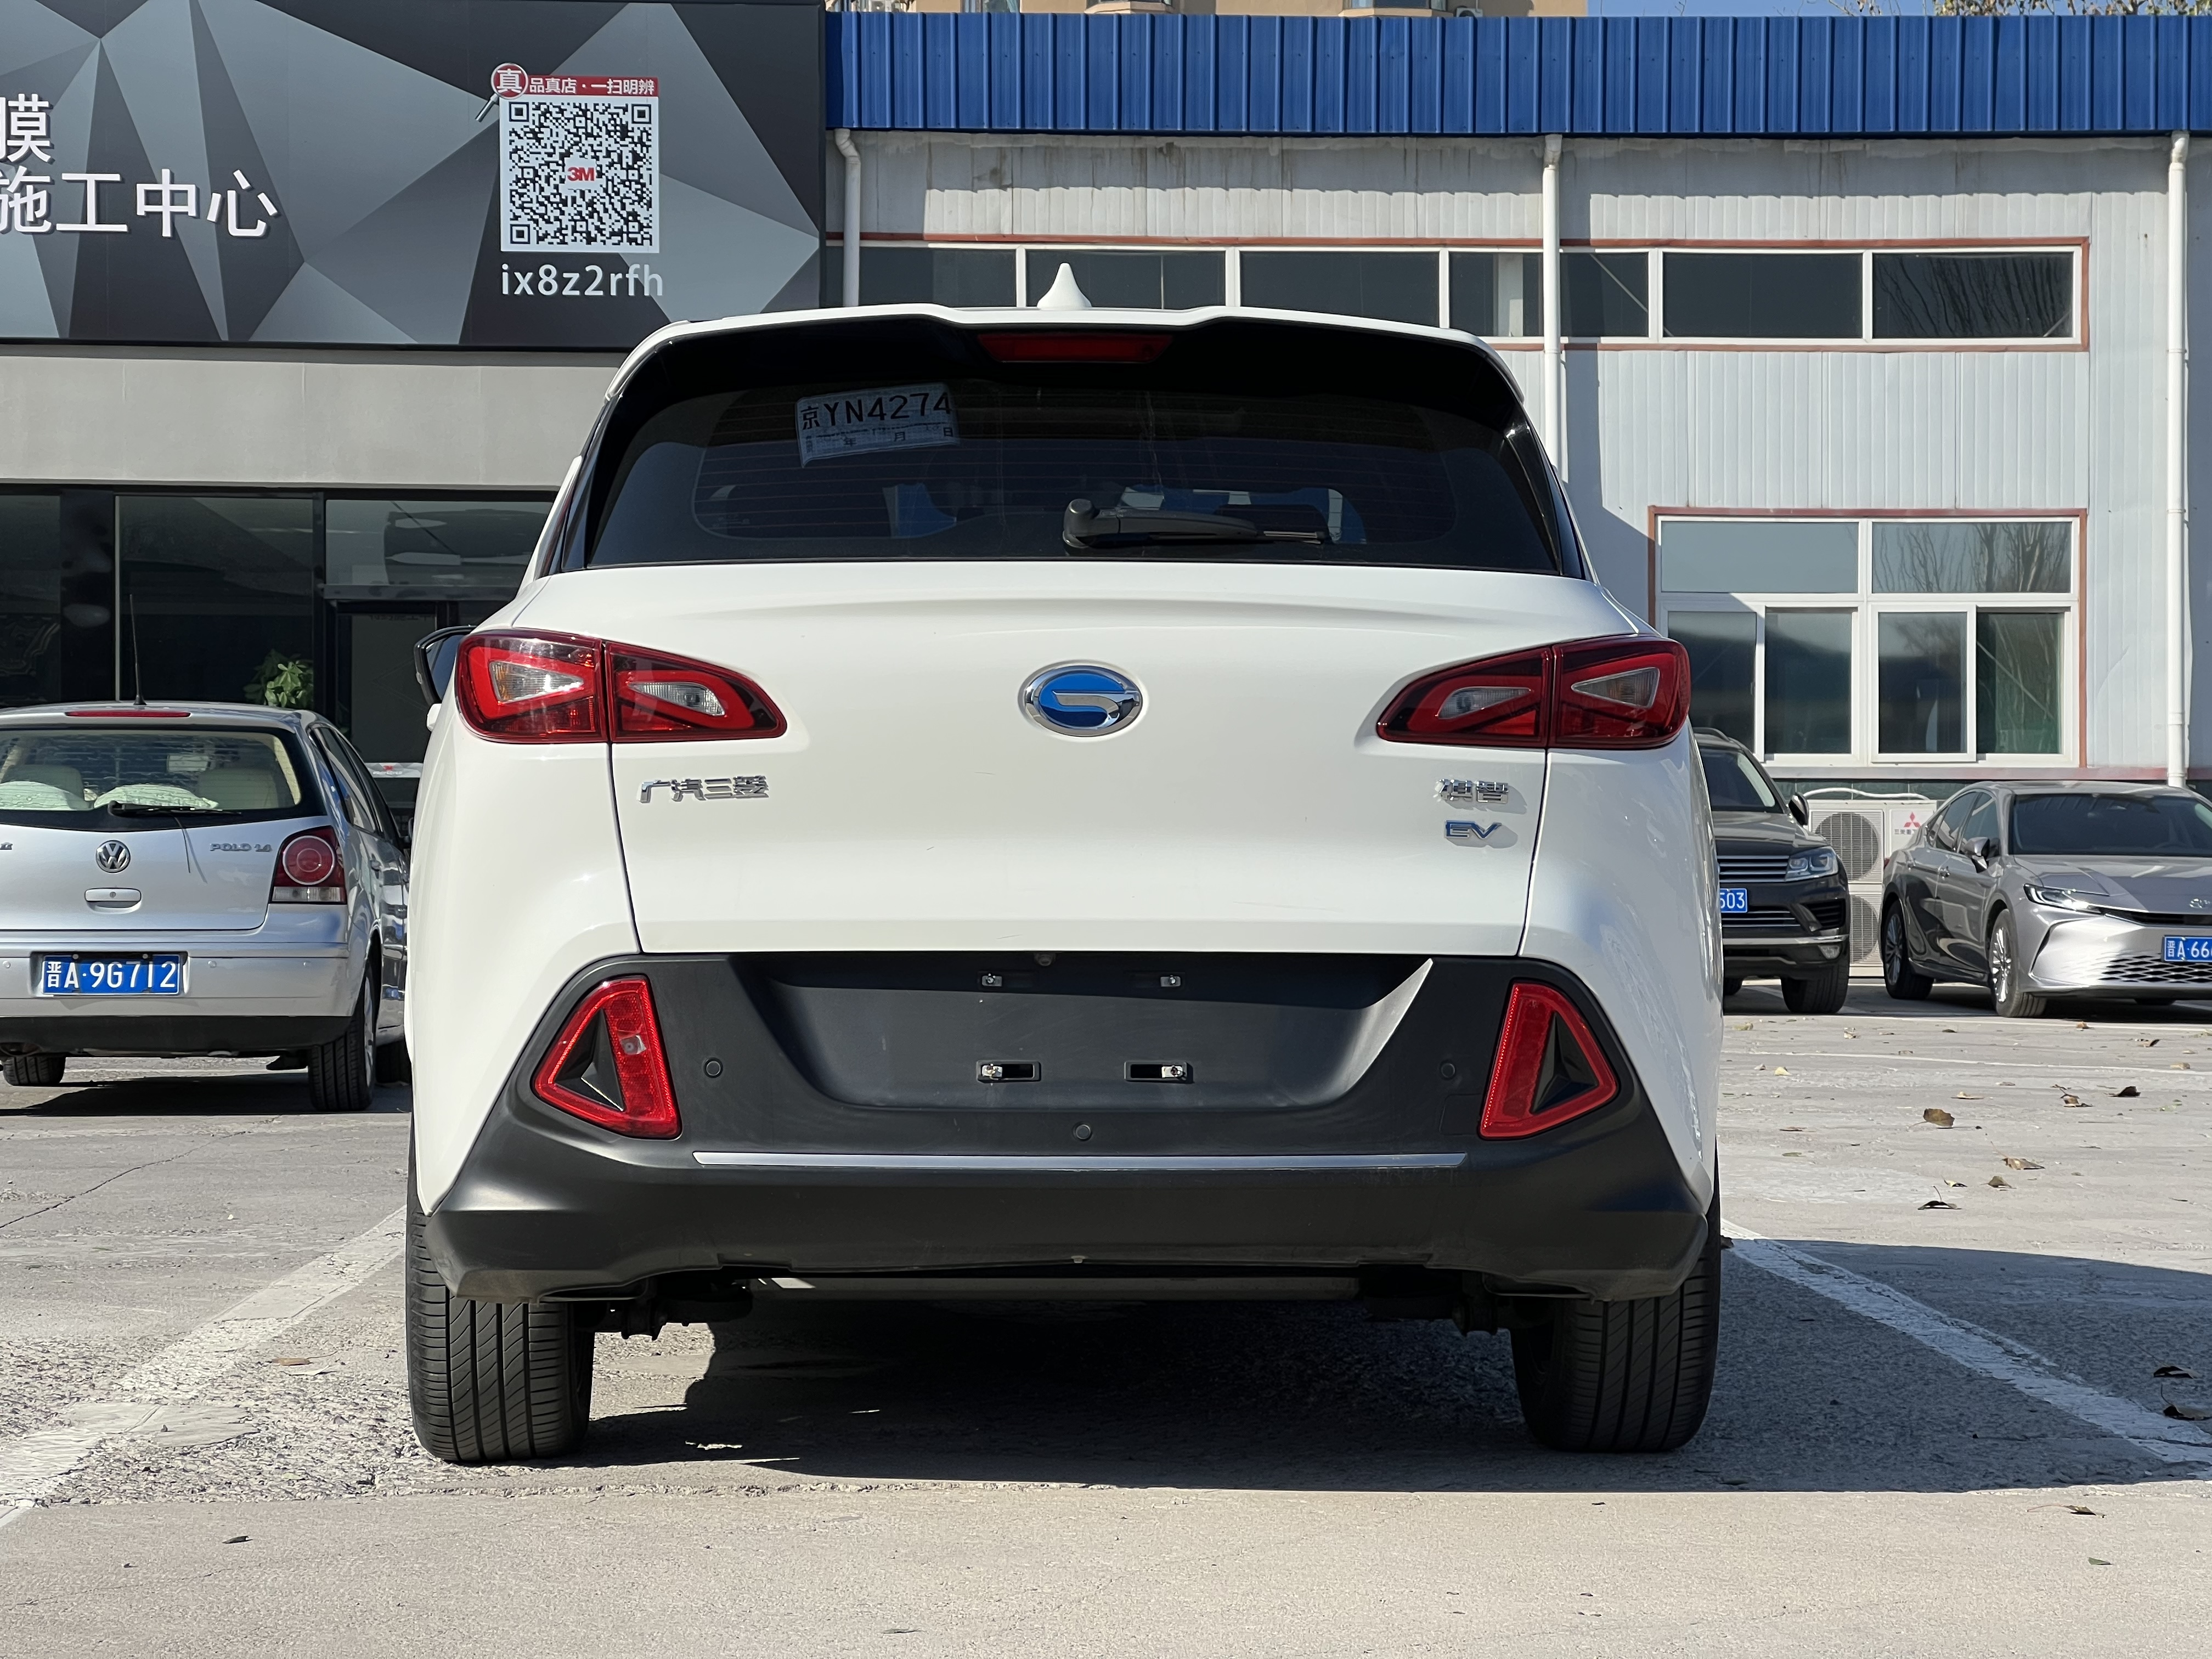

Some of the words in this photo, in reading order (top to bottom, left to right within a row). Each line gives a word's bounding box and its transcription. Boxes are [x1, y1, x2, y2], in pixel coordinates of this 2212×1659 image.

[567, 167, 595, 182] 3M
[0, 166, 278, 237] 施工中心
[501, 263, 663, 296] ix8z2rfh
[801, 392, 952, 431] 京YN4274
[894, 431, 906, 442] 月
[944, 427, 953, 437] 日
[1445, 820, 1502, 839] EV
[210, 843, 252, 851] POLO
[2167, 940, 2212, 958] 晋A·66
